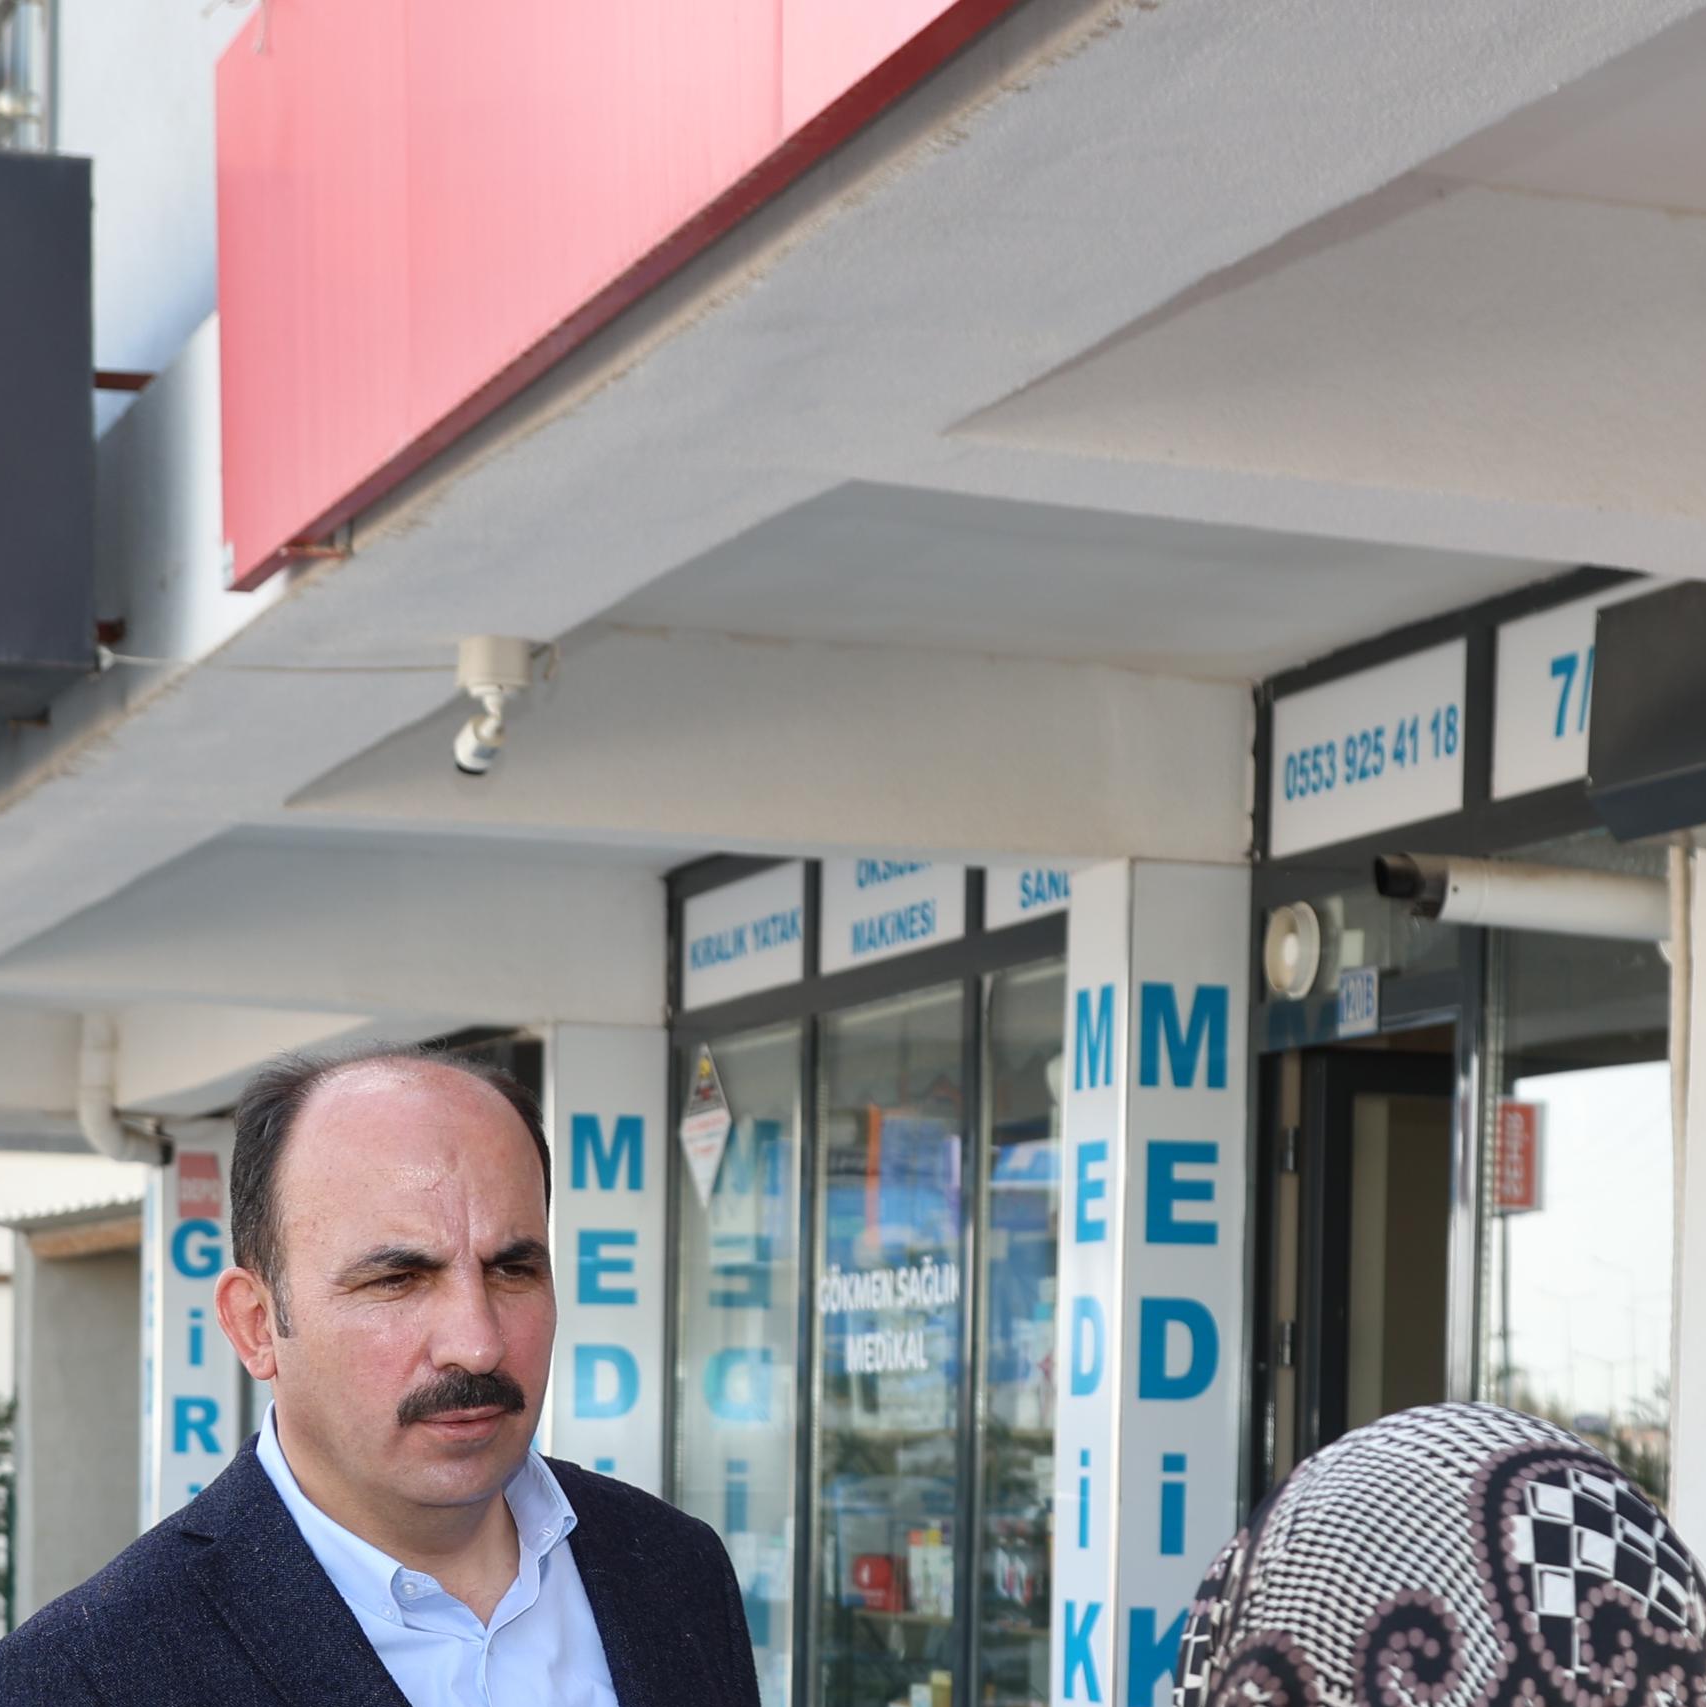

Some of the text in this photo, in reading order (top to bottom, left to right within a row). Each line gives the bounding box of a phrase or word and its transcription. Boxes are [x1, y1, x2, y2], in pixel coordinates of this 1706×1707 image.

[1284, 704, 1459, 801] 0553 925 41 18
[689, 906, 801, 970] KIRALIK YATAK
[569, 1114, 645, 1472] MED
[817, 1262, 893, 1314] GÖKMEN
[170, 1217, 224, 1500] GİR
[845, 1329, 929, 1373] MEDİKAL
